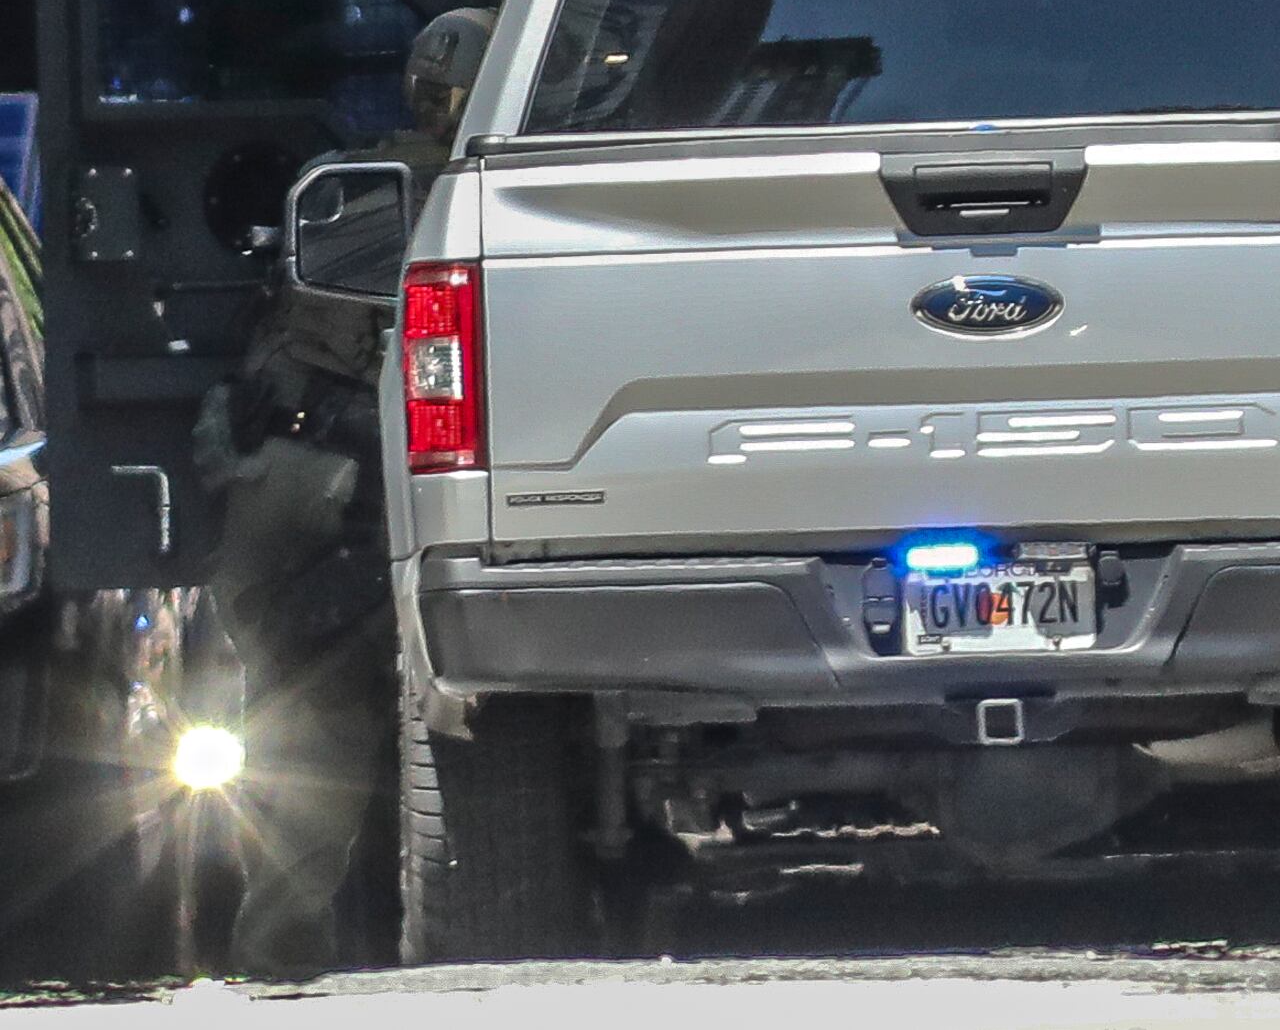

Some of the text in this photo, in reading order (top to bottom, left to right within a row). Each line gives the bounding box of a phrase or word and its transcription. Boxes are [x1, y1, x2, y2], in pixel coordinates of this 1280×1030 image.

[948, 295, 1028, 322] Ford
[706, 402, 1278, 465] F-150
[930, 580, 1081, 629] GV0472N
